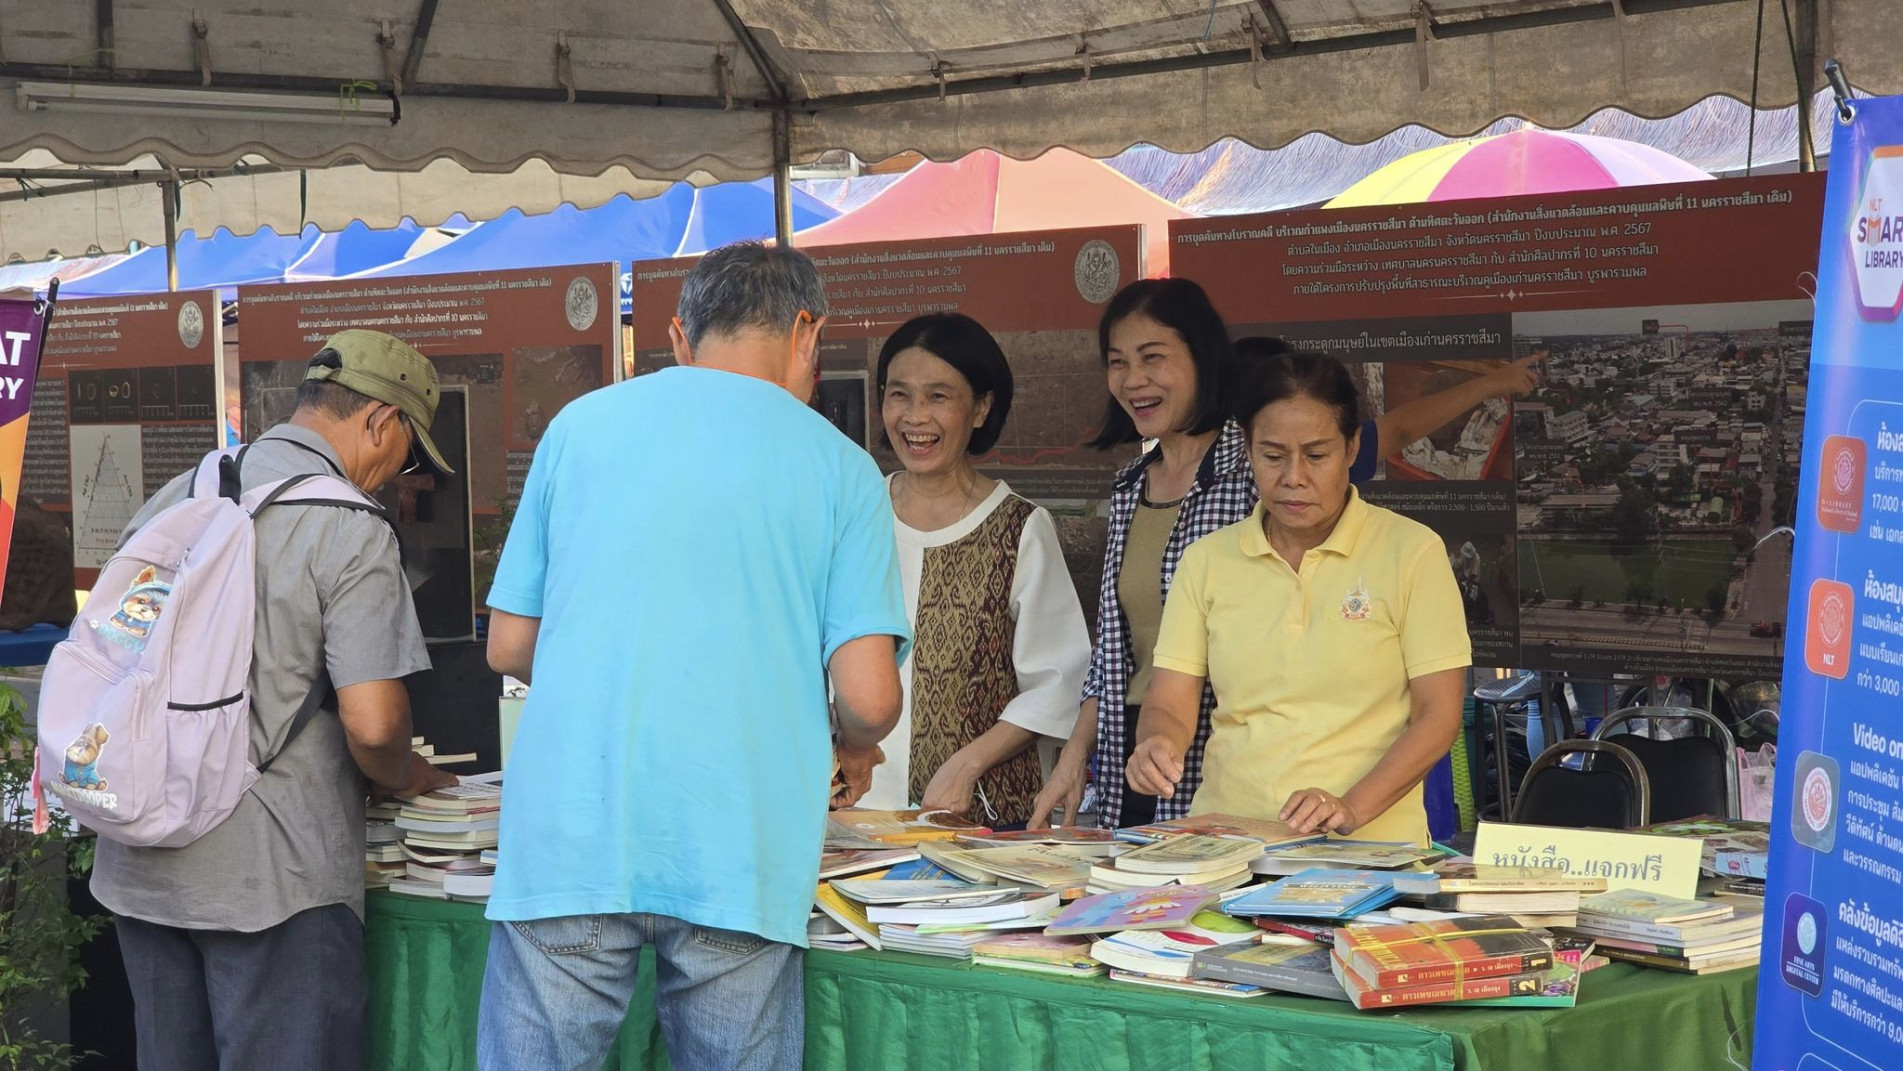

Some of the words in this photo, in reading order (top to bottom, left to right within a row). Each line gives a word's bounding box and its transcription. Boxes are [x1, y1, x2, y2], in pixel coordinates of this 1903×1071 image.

[1409, 211, 1485, 229] ด้านทิศตะวันออก
[1686, 197, 1698, 209] 11
[1702, 190, 1764, 208] นครราชสีมา
[1767, 188, 1792, 203] เดิม)
[1288, 240, 1341, 256] ตำบลในเมือง
[1344, 234, 1443, 253] อำเภอเมืองนครราชสีมา
[1446, 229, 1531, 247] จังหวัดนครราชสีมา
[1534, 226, 1596, 241] ปีงบประมาณ
[1601, 225, 1620, 237] พ.ศ.
[1624, 222, 1652, 235] 2567
[984, 246, 992, 256] 11
[1282, 258, 1379, 276] โดยความร่วมมือระหว่าง
[1382, 252, 1487, 270] เทศบาลนครนครราชสีมา
[1491, 251, 1505, 265] กับ
[1508, 244, 1581, 264] สำนักศิลปากรที่
[1585, 247, 1597, 259] 10
[1602, 241, 1659, 257] นครราชสีมา
[943, 265, 962, 276] 2567
[1587, 265, 1647, 284] บูรพารวมพล
[916, 285, 925, 295] 10
[1872, 493, 1899, 513] 17,000
[1823, 653, 1836, 666] NLT
[1874, 674, 1900, 697] 3,000
[1853, 722, 1887, 755] Video
[1848, 789, 1890, 822] การประชุม
